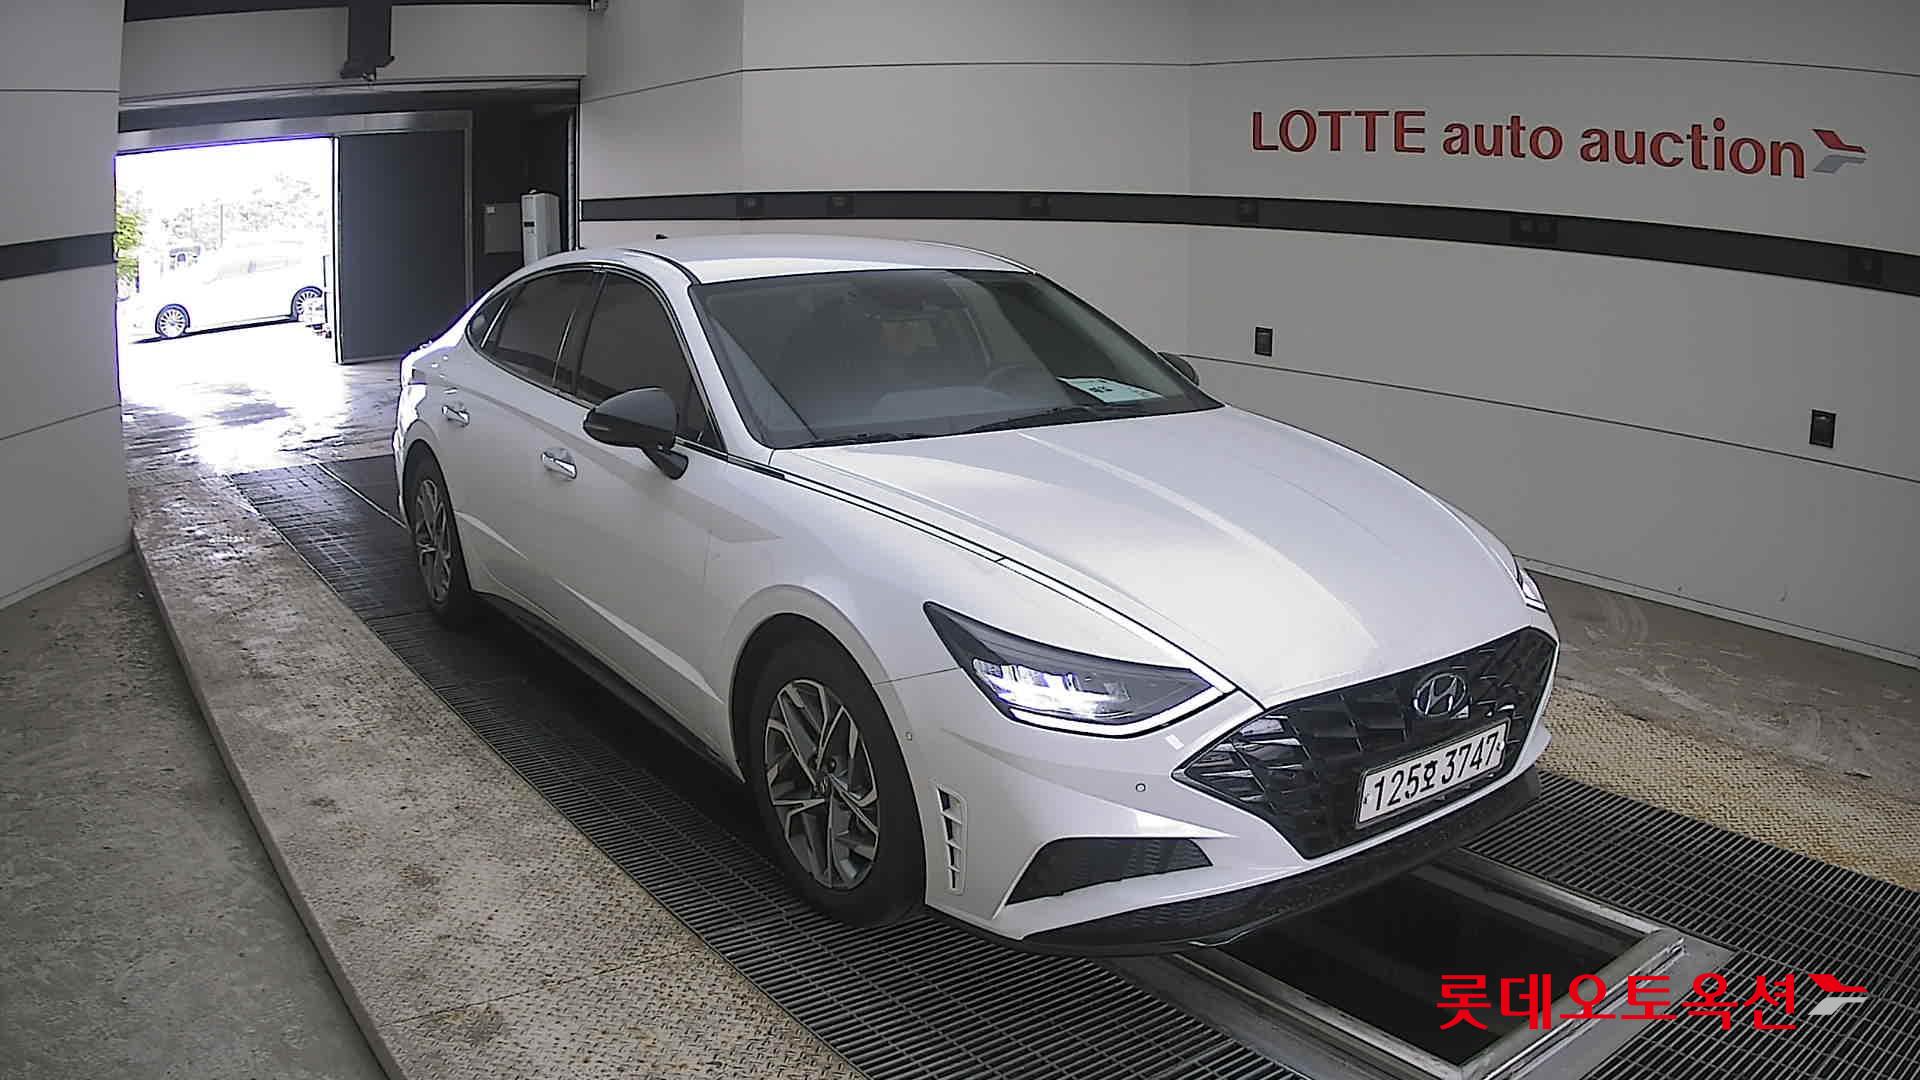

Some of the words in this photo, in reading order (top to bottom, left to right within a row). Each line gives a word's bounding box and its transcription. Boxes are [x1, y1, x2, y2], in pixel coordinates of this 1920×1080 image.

[1252, 110, 1426, 153] LOTTE
[1442, 115, 1563, 160] auto
[1580, 118, 1806, 179] auction
[1374, 760, 1438, 811] 125호
[1441, 732, 1499, 784] 3747
